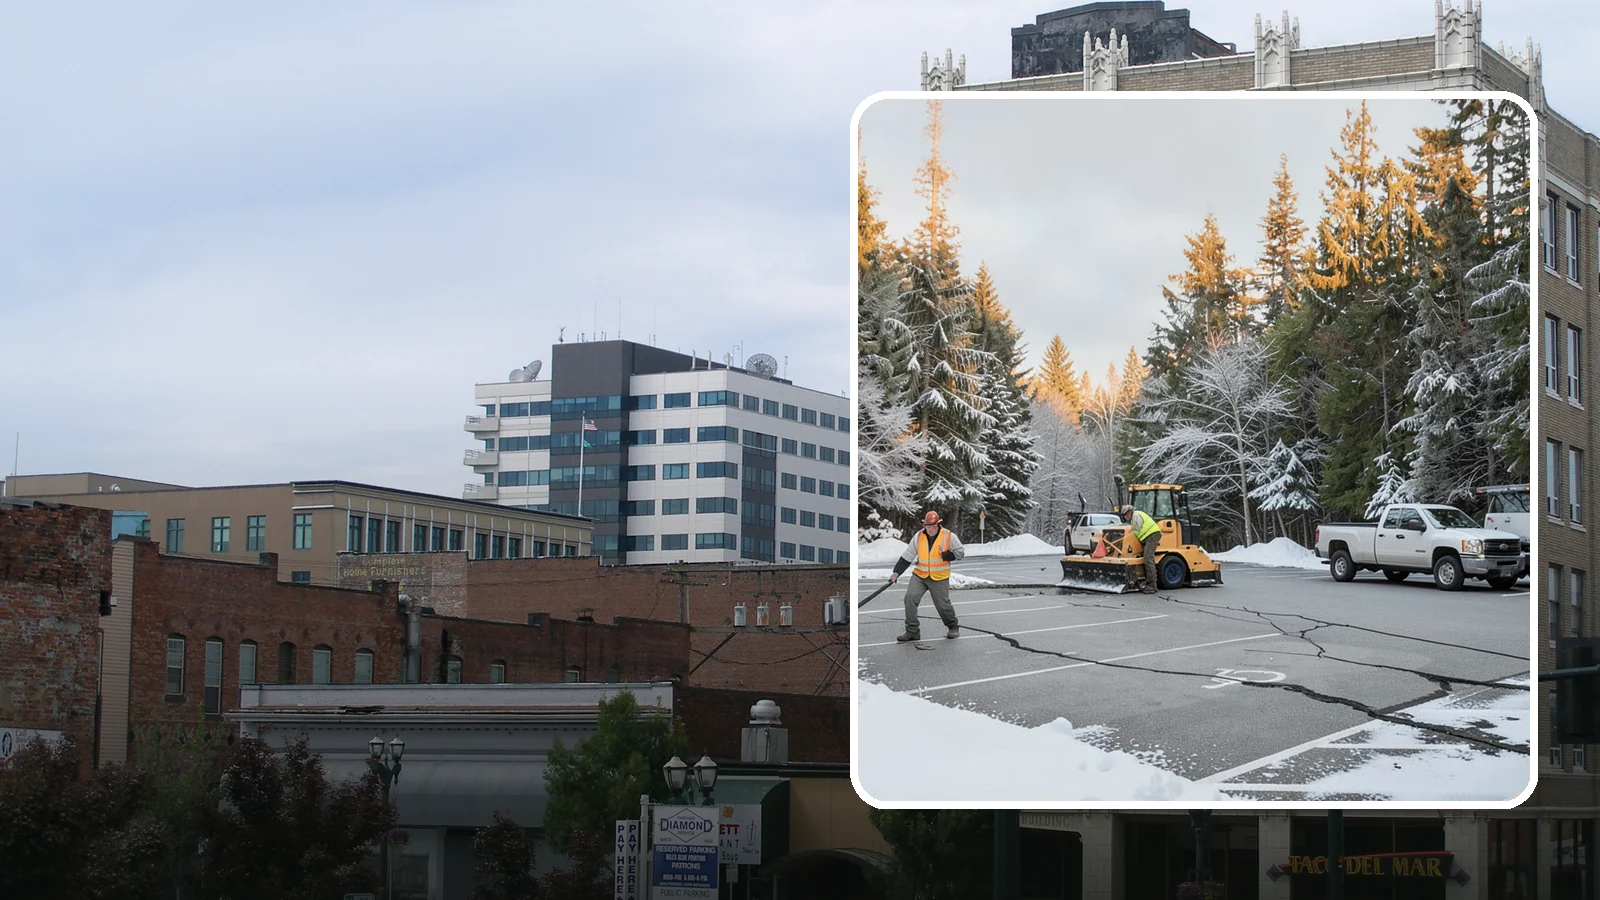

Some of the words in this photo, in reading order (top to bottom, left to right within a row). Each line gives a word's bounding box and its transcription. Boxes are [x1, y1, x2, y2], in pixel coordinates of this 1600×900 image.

[343, 568, 368, 577] Home
[370, 566, 427, 577] Furnishers
[660, 818, 713, 833] DIAMOND
[1022, 815, 1070, 828] BUILDING
[617, 824, 625, 852] PAY
[629, 824, 637, 852] PAY
[656, 845, 688, 853] RESERVED
[689, 846, 716, 854] PARKING
[721, 851, 739, 862] Soup
[671, 862, 701, 870] PATRONS
[1346, 856, 1385, 876] DEL
[1392, 857, 1442, 877] MAR
[616, 856, 625, 893] HERE
[627, 856, 636, 893] HERE
[660, 889, 682, 897] PUBLIC
[683, 889, 710, 898] PARKING
